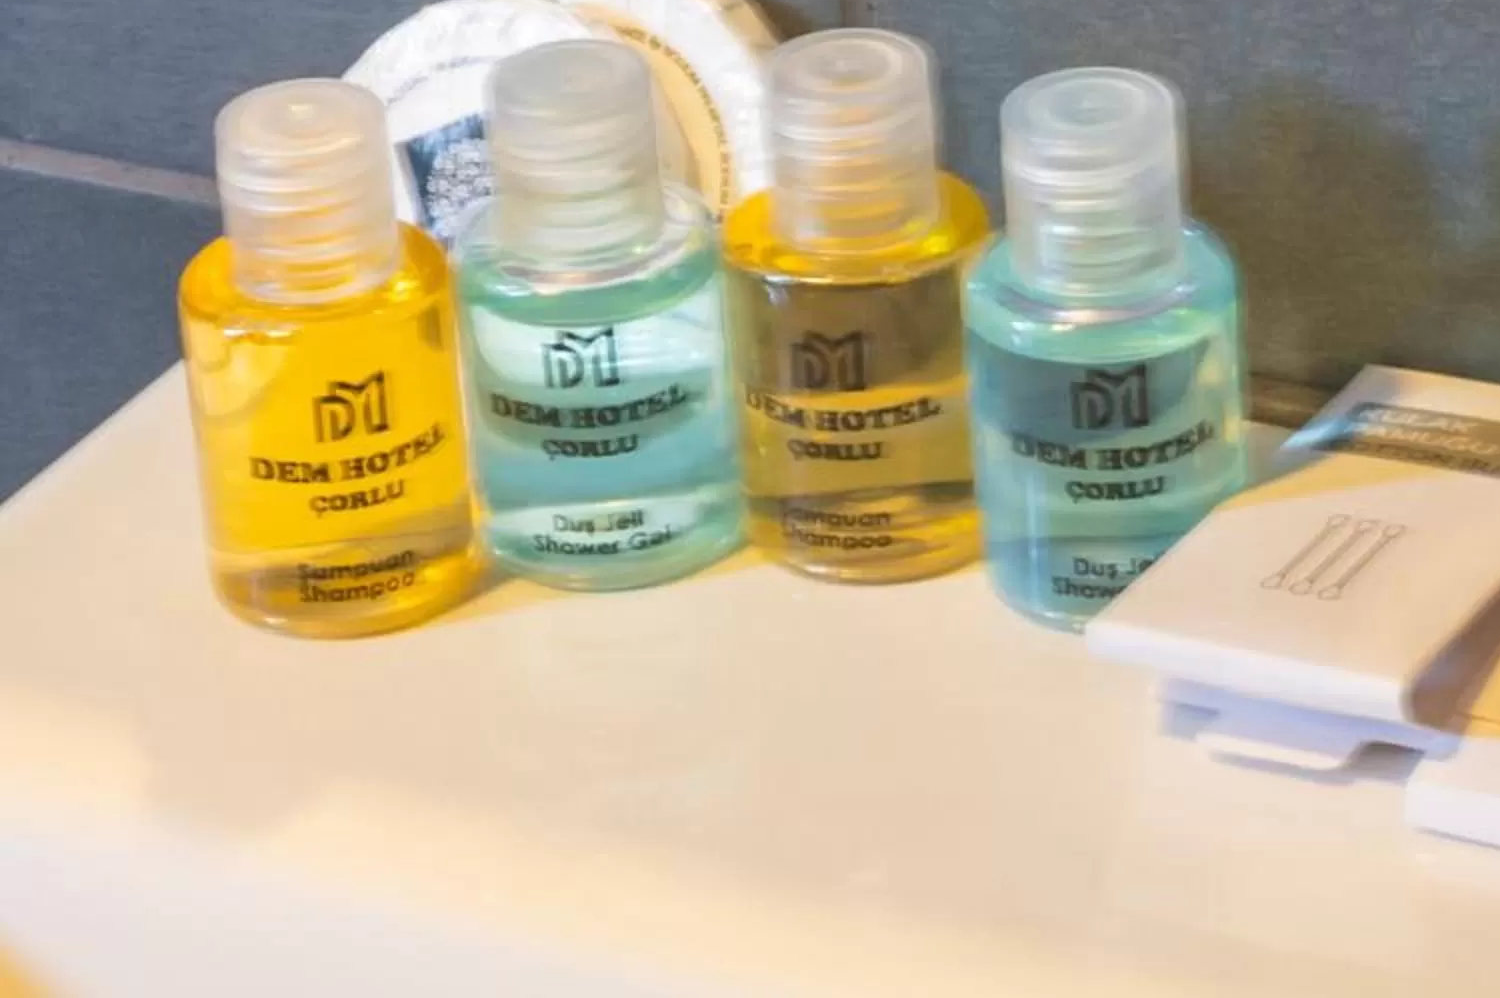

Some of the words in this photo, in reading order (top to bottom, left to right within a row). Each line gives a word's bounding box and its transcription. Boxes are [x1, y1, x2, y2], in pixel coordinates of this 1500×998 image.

[490, 392, 561, 428] DEM
[569, 382, 688, 430] HOTEL
[747, 390, 806, 428] DEM
[814, 396, 943, 431] HOTEL
[249, 456, 332, 484] DEM
[338, 422, 446, 481] HOTEL
[541, 433, 640, 462] ÇORLU
[787, 438, 885, 462] ÇORLU
[1012, 431, 1089, 470] DEM
[1097, 419, 1215, 471] HOTEL
[308, 479, 407, 519] ÇORLU
[1064, 475, 1166, 504] ÇORLU
[532, 533, 620, 555] Shower
[628, 524, 675, 551] Gel
[1073, 557, 1118, 580] Duş
[1124, 556, 1158, 576] Je
[1051, 576, 1128, 600] Show
